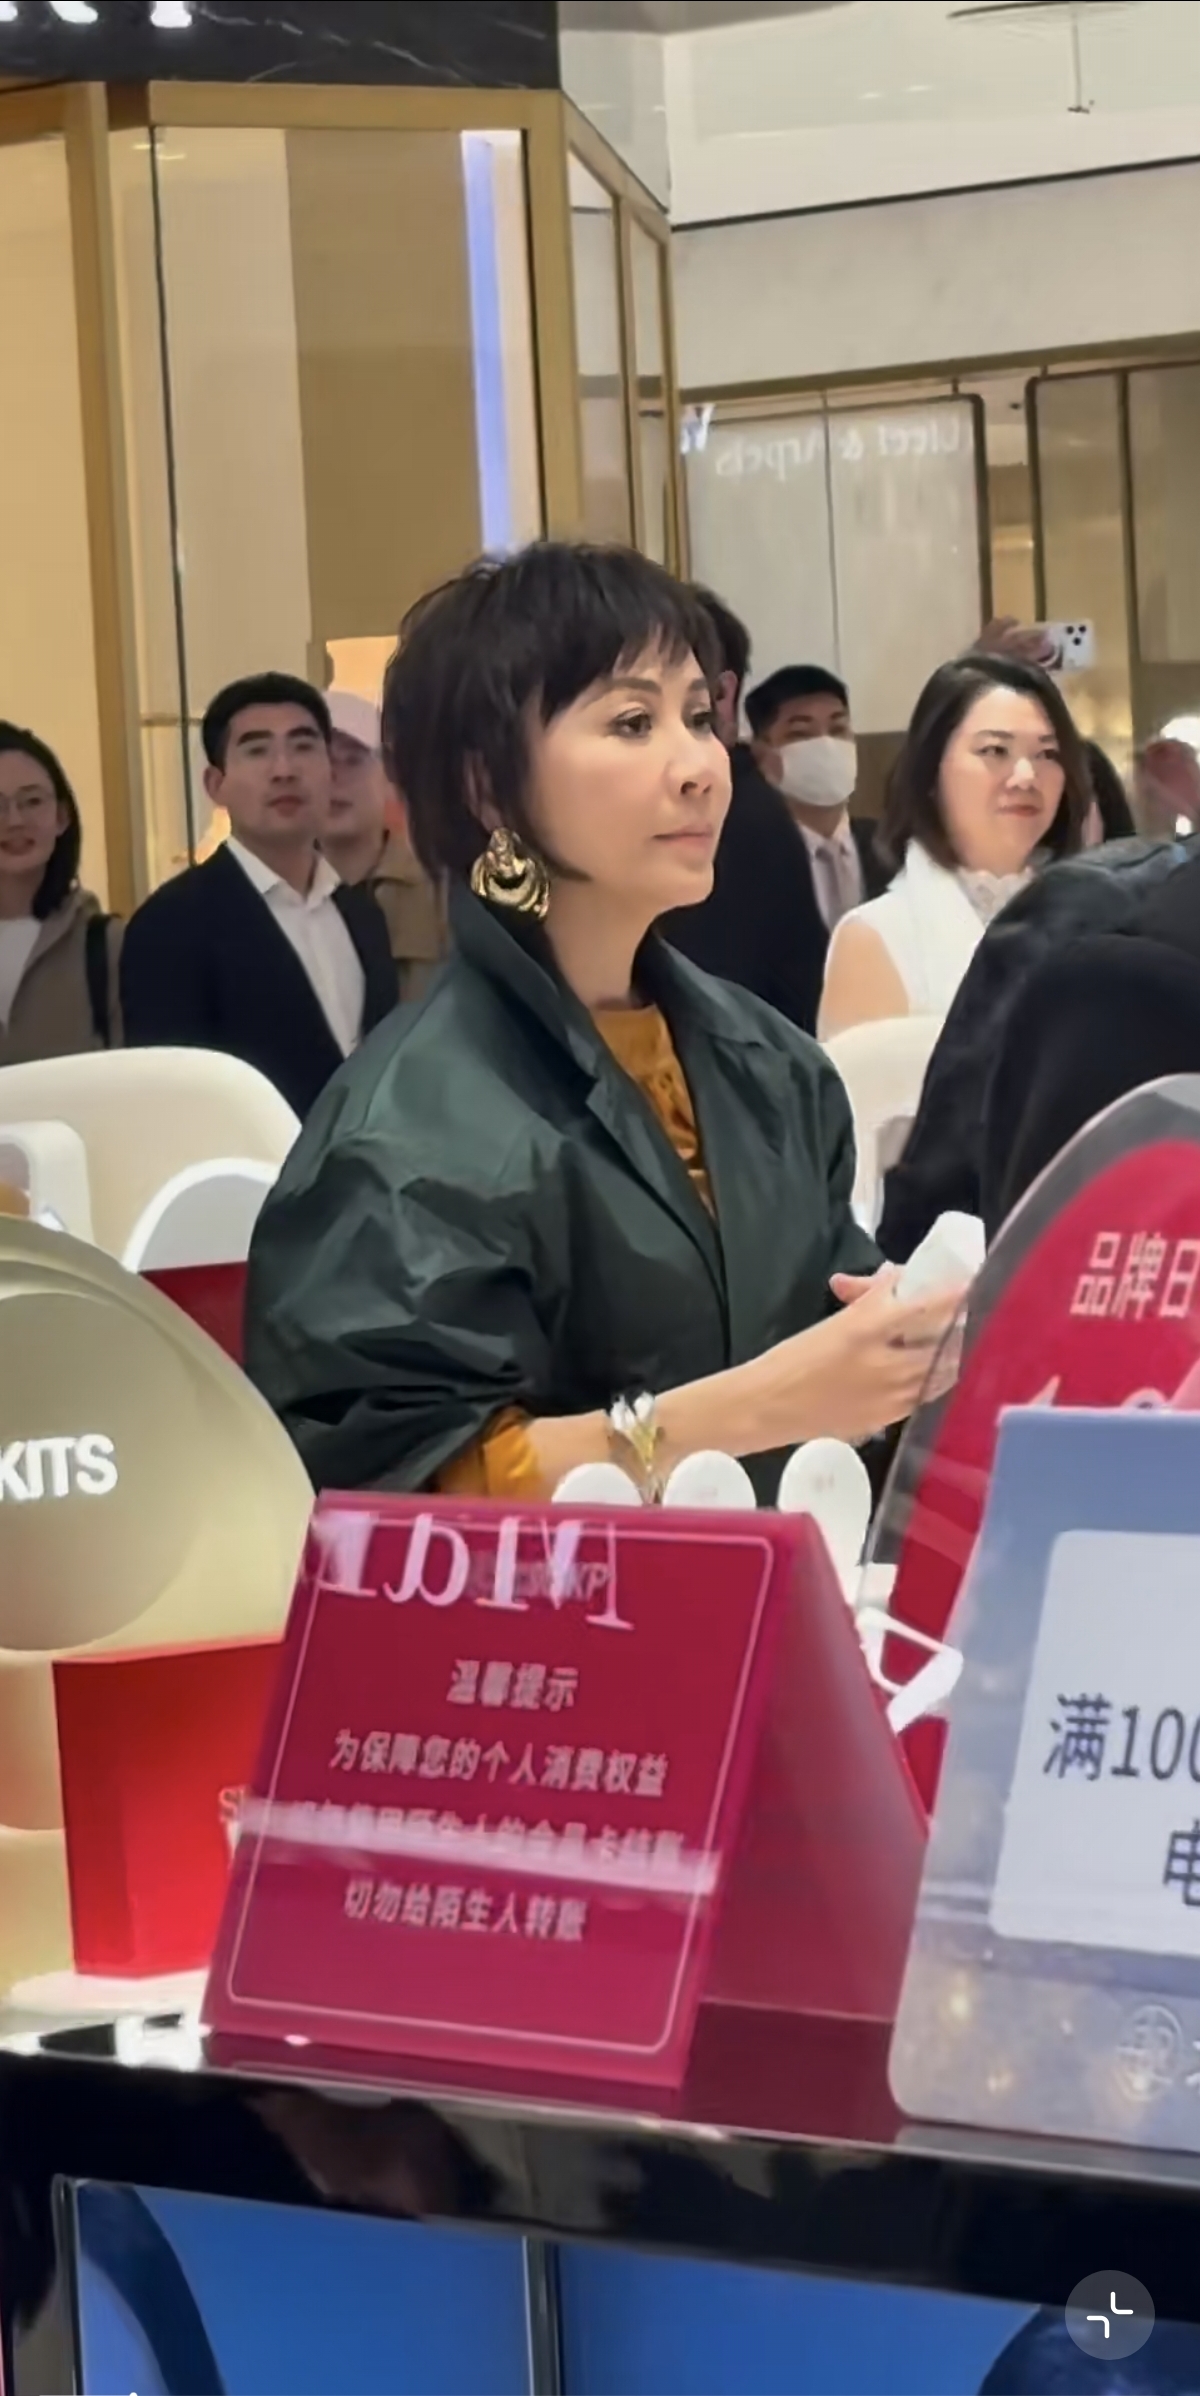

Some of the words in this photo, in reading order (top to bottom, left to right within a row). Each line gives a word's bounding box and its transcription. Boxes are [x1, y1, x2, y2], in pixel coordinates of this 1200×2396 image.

[0, 1433, 119, 1501] KITS
[329, 1728, 668, 1797] 为保障您的个人消费权益
[344, 1879, 588, 1942] 切勿给陌生人转账
